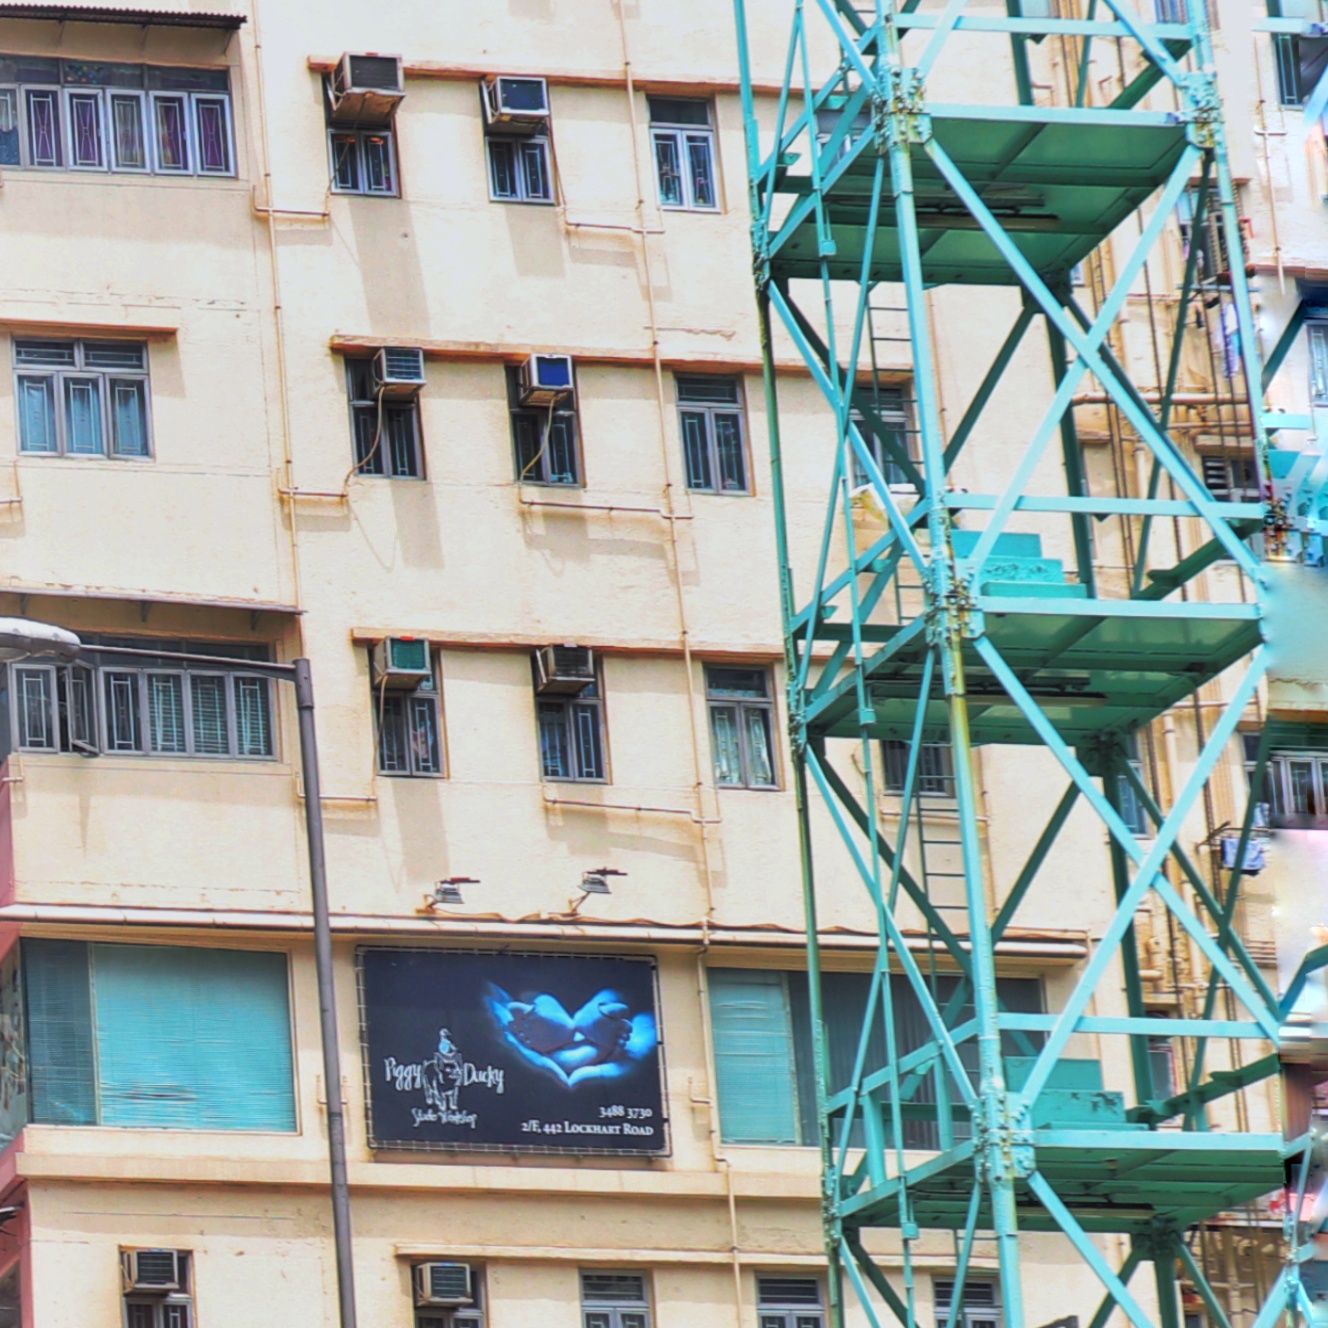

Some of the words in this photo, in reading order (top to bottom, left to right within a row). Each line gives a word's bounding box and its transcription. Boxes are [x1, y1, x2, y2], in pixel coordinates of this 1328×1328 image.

[384, 1057, 422, 1092] Piggy
[463, 1061, 505, 1094] Ducky
[599, 1106, 625, 1119] 3488
[627, 1108, 653, 1119] 3730
